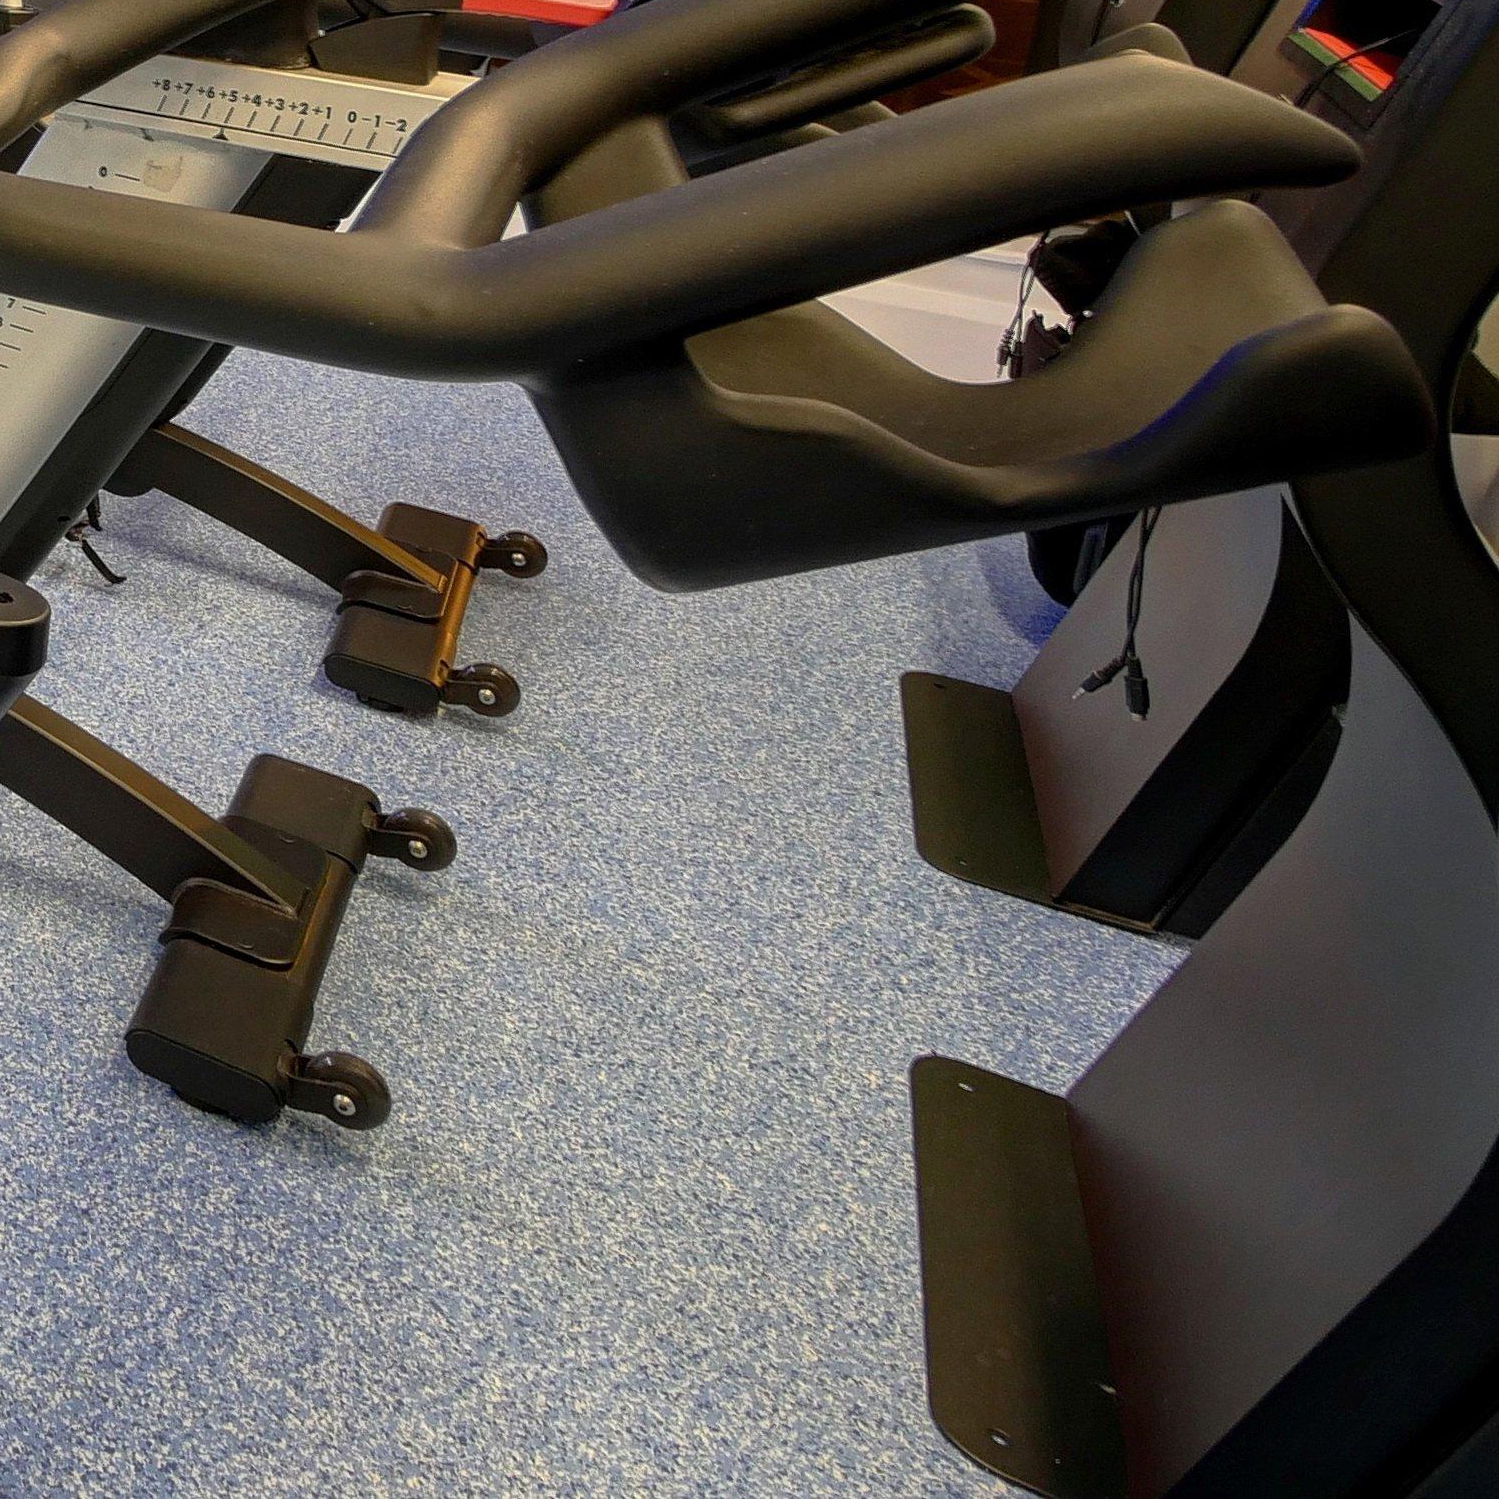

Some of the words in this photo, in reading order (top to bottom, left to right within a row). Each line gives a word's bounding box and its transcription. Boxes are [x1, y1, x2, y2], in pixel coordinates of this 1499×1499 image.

[152, 78, 171, 91] +8
[174, 82, 194, 95] +7
[197, 85, 215, 98] +6
[218, 90, 238, 103] +5
[242, 94, 262, 107] +4
[264, 98, 286, 111] +3
[288, 102, 309, 116] +2
[312, 106, 332, 120] +1
[346, 110, 357, 124] 0
[362, 114, 381, 128] -1
[99, 166, 108, 178] 0
[6, 297, 16, 308] 7
